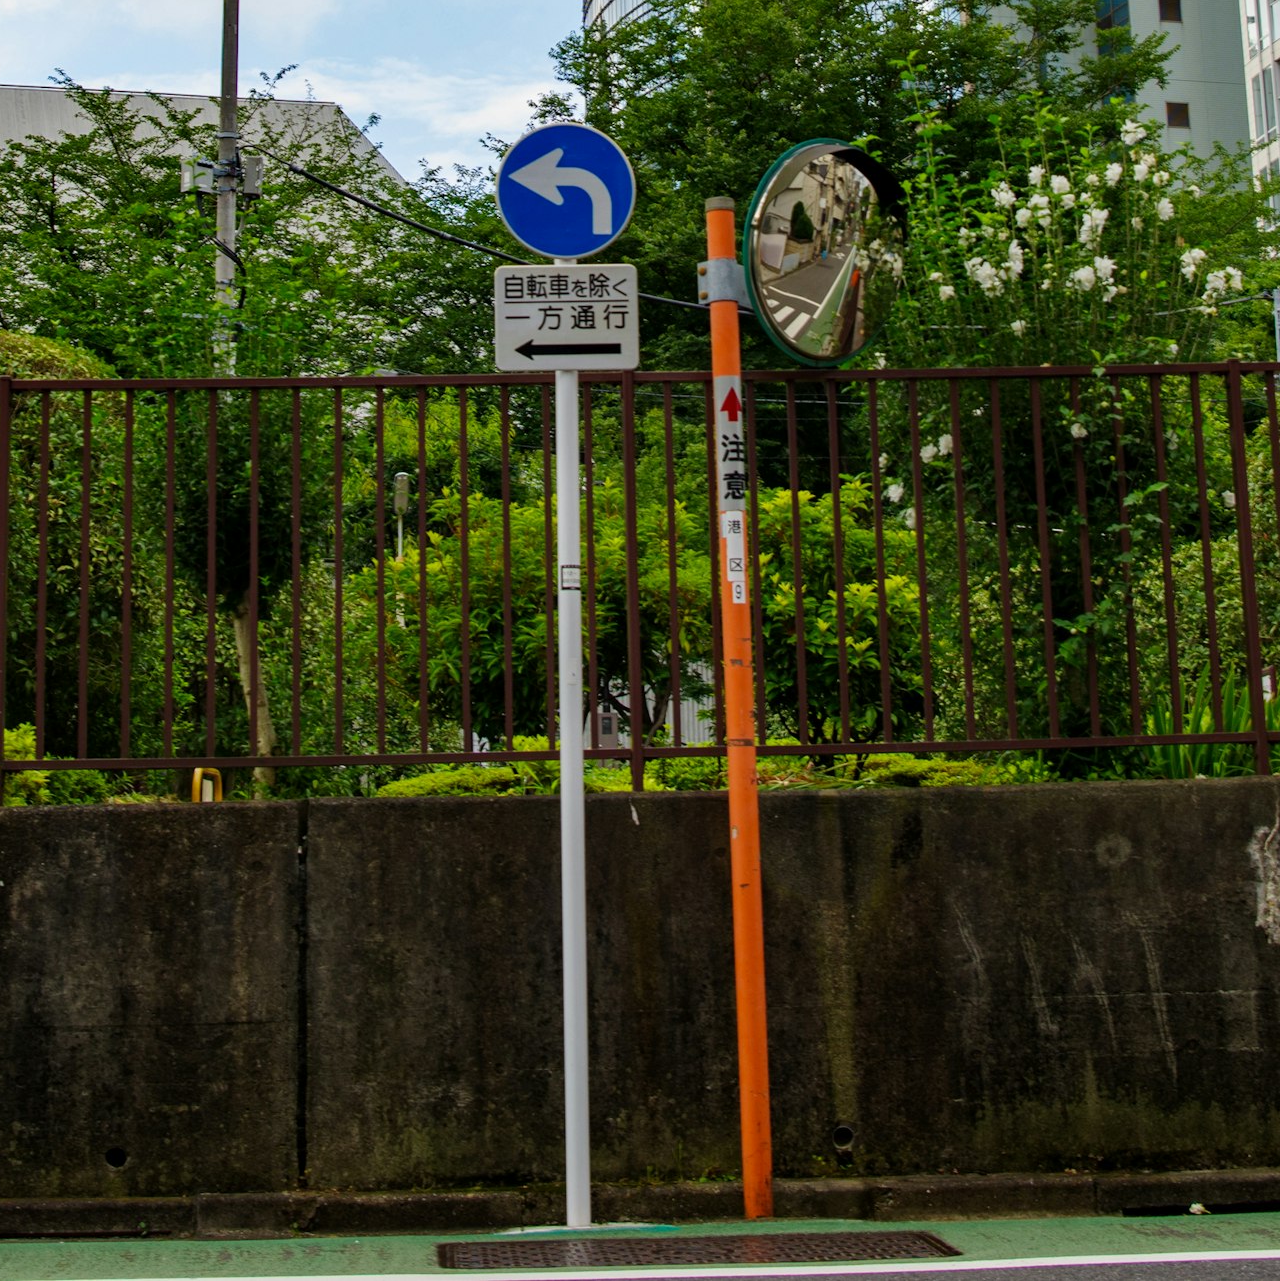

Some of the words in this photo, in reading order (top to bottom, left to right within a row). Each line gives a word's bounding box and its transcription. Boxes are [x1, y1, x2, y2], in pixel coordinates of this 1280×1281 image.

[504, 273, 628, 299] 自転車を除く
[505, 304, 630, 331] 一方通行
[721, 433, 748, 501] 注意
[728, 520, 744, 572] 港区
